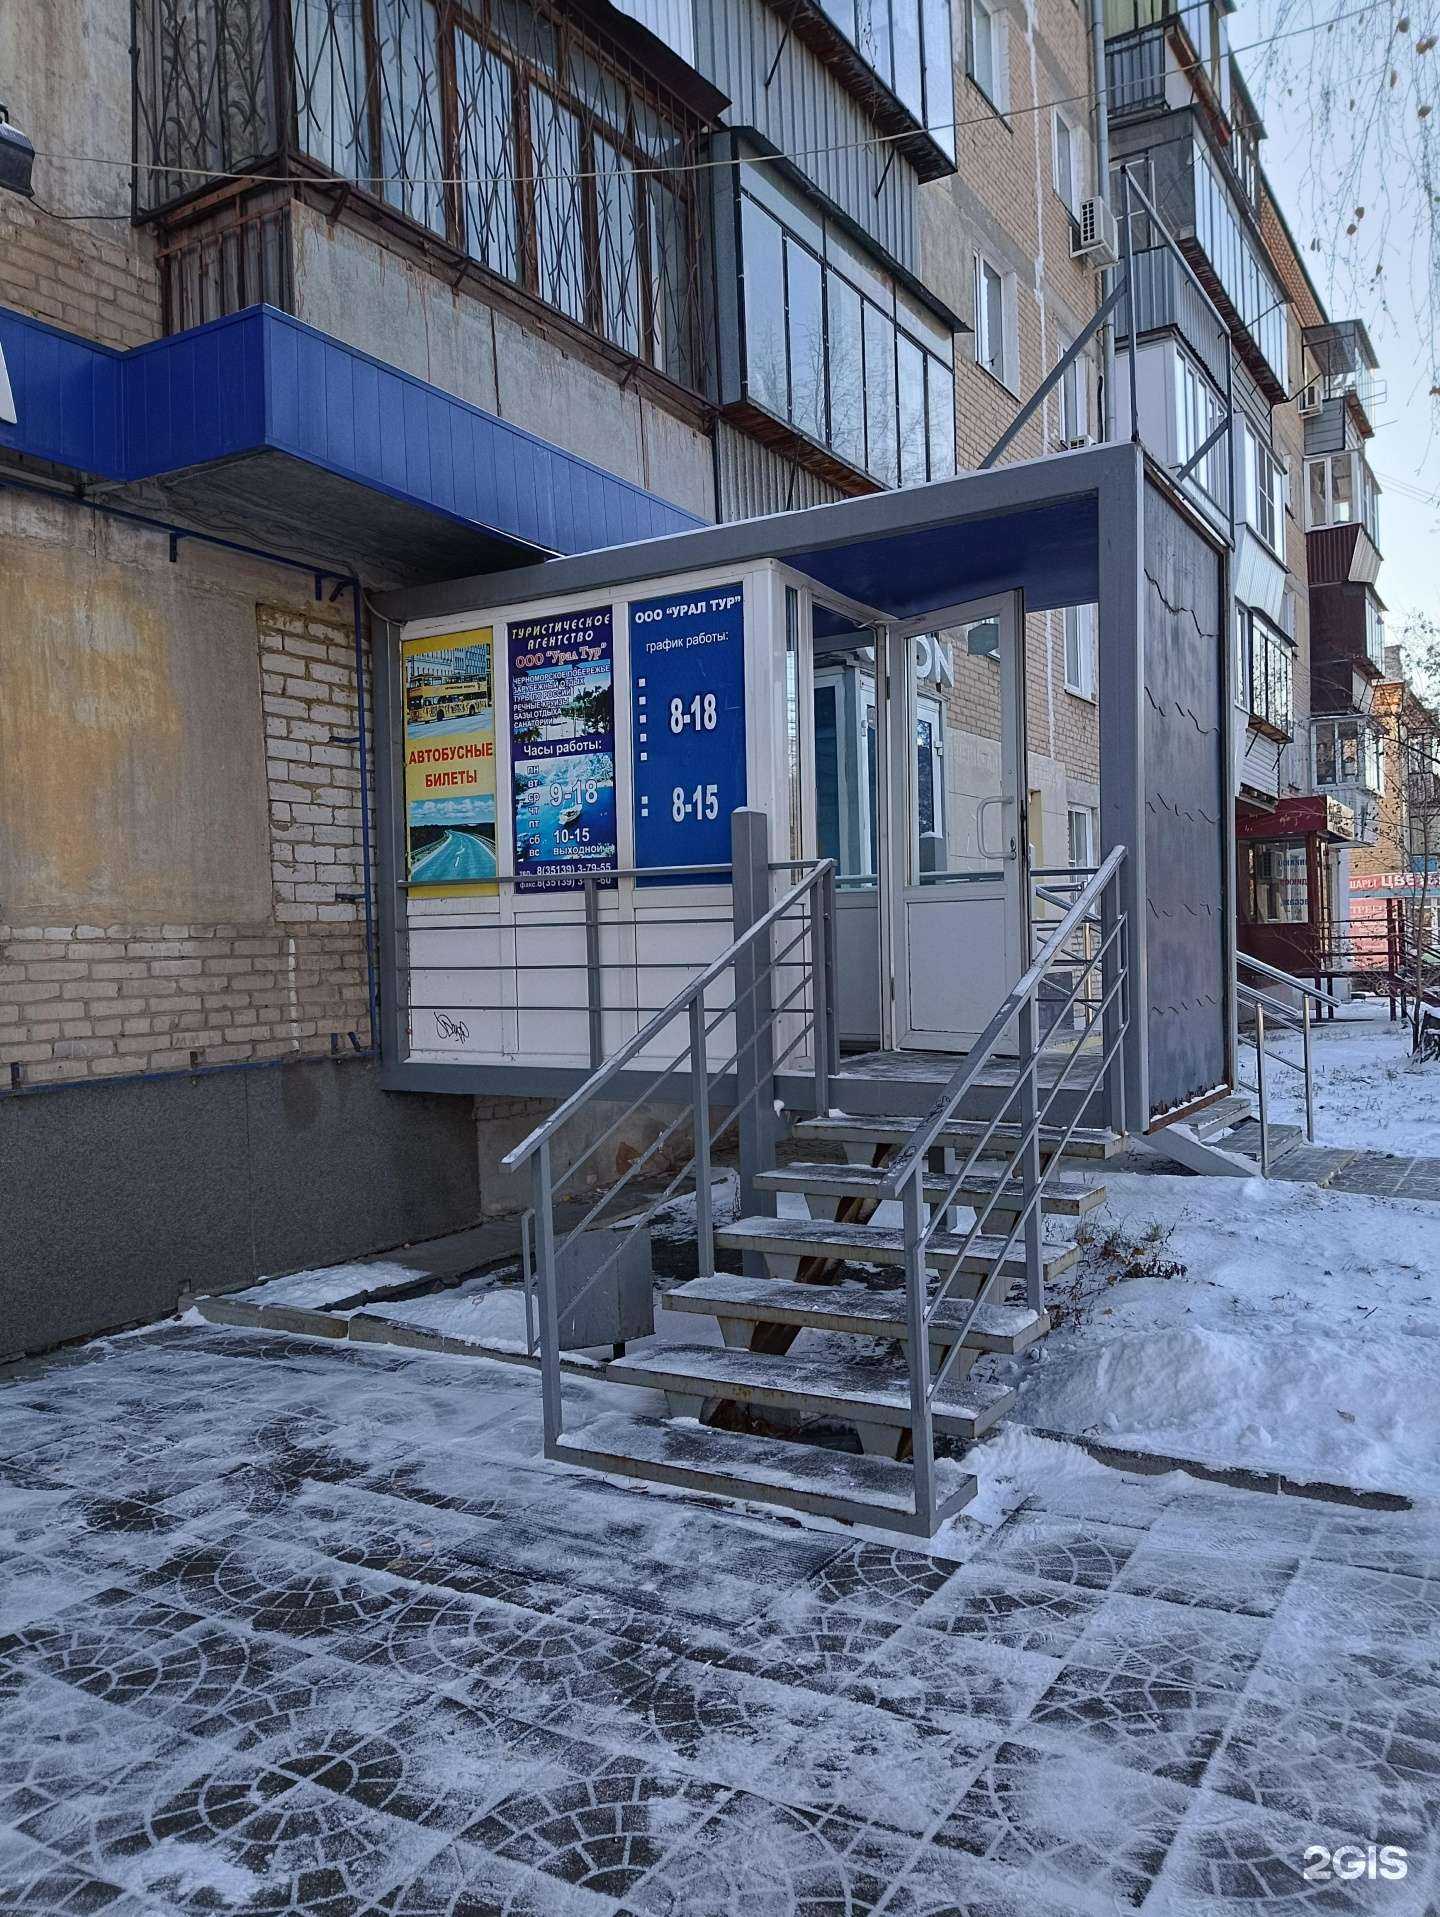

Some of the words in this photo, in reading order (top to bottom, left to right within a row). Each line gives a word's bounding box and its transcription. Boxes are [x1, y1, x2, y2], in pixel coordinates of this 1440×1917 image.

[635, 608, 663, 624] ООО
[512, 613, 610, 639] ТУРИСТИЧЕСКОЕ
[527, 630, 593, 650] АГЕНТСТВО
[646, 638, 683, 654] график
[686, 631, 729, 649] работы:
[515, 652, 544, 669] ООО
[512, 672, 567, 686] ЧЕРНОМОРСКОЕ
[567, 664, 611, 678] ПОБЕРЕЖЬЕ
[513, 693, 531, 703] ТУРЫ
[543, 688, 571, 699] РОССИИ
[513, 701, 540, 711] РЕЧНЫЕ
[513, 711, 532, 721] БАЗЫ
[533, 708, 561, 718] ОТДЫХА
[670, 693, 717, 734] 8-18
[409, 742, 493, 765] АВТОБУСНЫЕ
[524, 745, 553, 756] Часы
[556, 740, 602, 755] работы:
[425, 769, 477, 788] БИЛЕТЫ
[549, 779, 598, 806] 9-18
[672, 784, 719, 822] 8-15
[554, 828, 590, 843] 10-15
[537, 864, 575, 876] 8(35139)
[577, 863, 611, 873] 3-79-55
